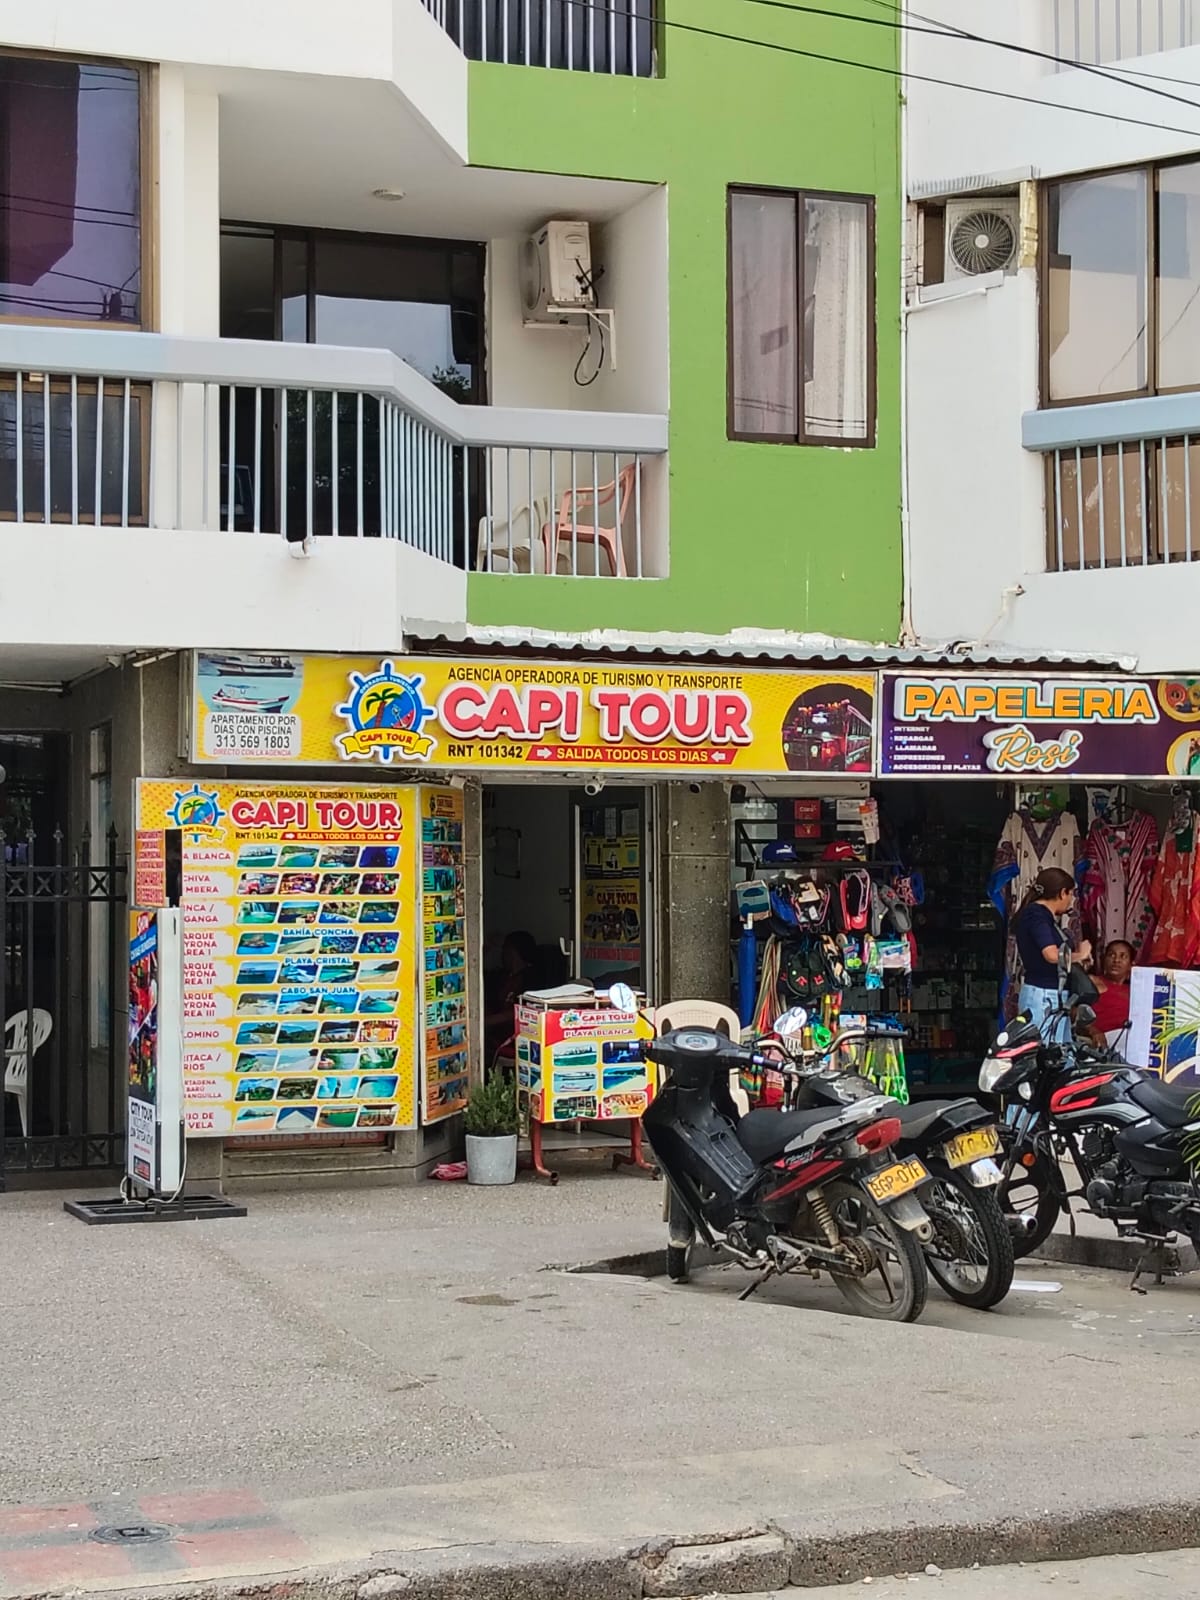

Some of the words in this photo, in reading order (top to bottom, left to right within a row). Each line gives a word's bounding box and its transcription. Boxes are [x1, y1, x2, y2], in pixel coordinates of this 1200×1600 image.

[448, 667, 502, 682] AGENCIA
[505, 669, 580, 684] OPERADORA
[583, 672, 598, 684] DE
[602, 672, 654, 687] TURISMO
[656, 674, 664, 686] Y
[667, 674, 743, 689] TRANSPORTE
[903, 684, 1157, 720] PAPELERIA
[442, 686, 580, 735] CAPI
[597, 692, 750, 738] TOUR
[211, 714, 276, 726] APARTAMENTO
[277, 715, 297, 726] POR
[214, 724, 235, 735] DIAS
[236, 725, 256, 735] CON
[258, 725, 293, 736] PISCINA
[216, 734, 237, 748] 313
[240, 735, 260, 748] 569
[264, 735, 290, 749] 1803
[359, 733, 383, 743] CAPI
[386, 732, 413, 744] TOUR
[213, 748, 240, 756] DIRECTO
[265, 749, 292, 757] AGENCIA
[448, 744, 474, 757] RNT
[478, 745, 523, 758] 101342
[556, 747, 602, 760] SALIDA
[605, 749, 649, 761] TODOS
[652, 750, 677, 761] LOS
[680, 750, 708, 762] DIAS
[235, 790, 265, 798] AGENCIA
[265, 790, 308, 799] OPERADORA
[308, 791, 318, 799] DE
[319, 791, 349, 800] TURISMO
[355, 791, 398, 800] TRANSPORTE
[230, 800, 306, 826] CAPI
[315, 801, 400, 828] TOUR
[235, 831, 250, 839] RNT
[252, 832, 278, 840] 101342
[296, 832, 324, 840] SALIDA
[192, 852, 231, 860] BLANCA
[183, 915, 219, 923] GANGA
[183, 932, 215, 940] ARQUE
[314, 928, 354, 936] CONCHA
[184, 940, 217, 948] YRONA
[183, 962, 214, 970] ARQUE
[184, 977, 203, 985] REA
[184, 1001, 217, 1009] YRONA
[188, 1121, 214, 1129] VELA
